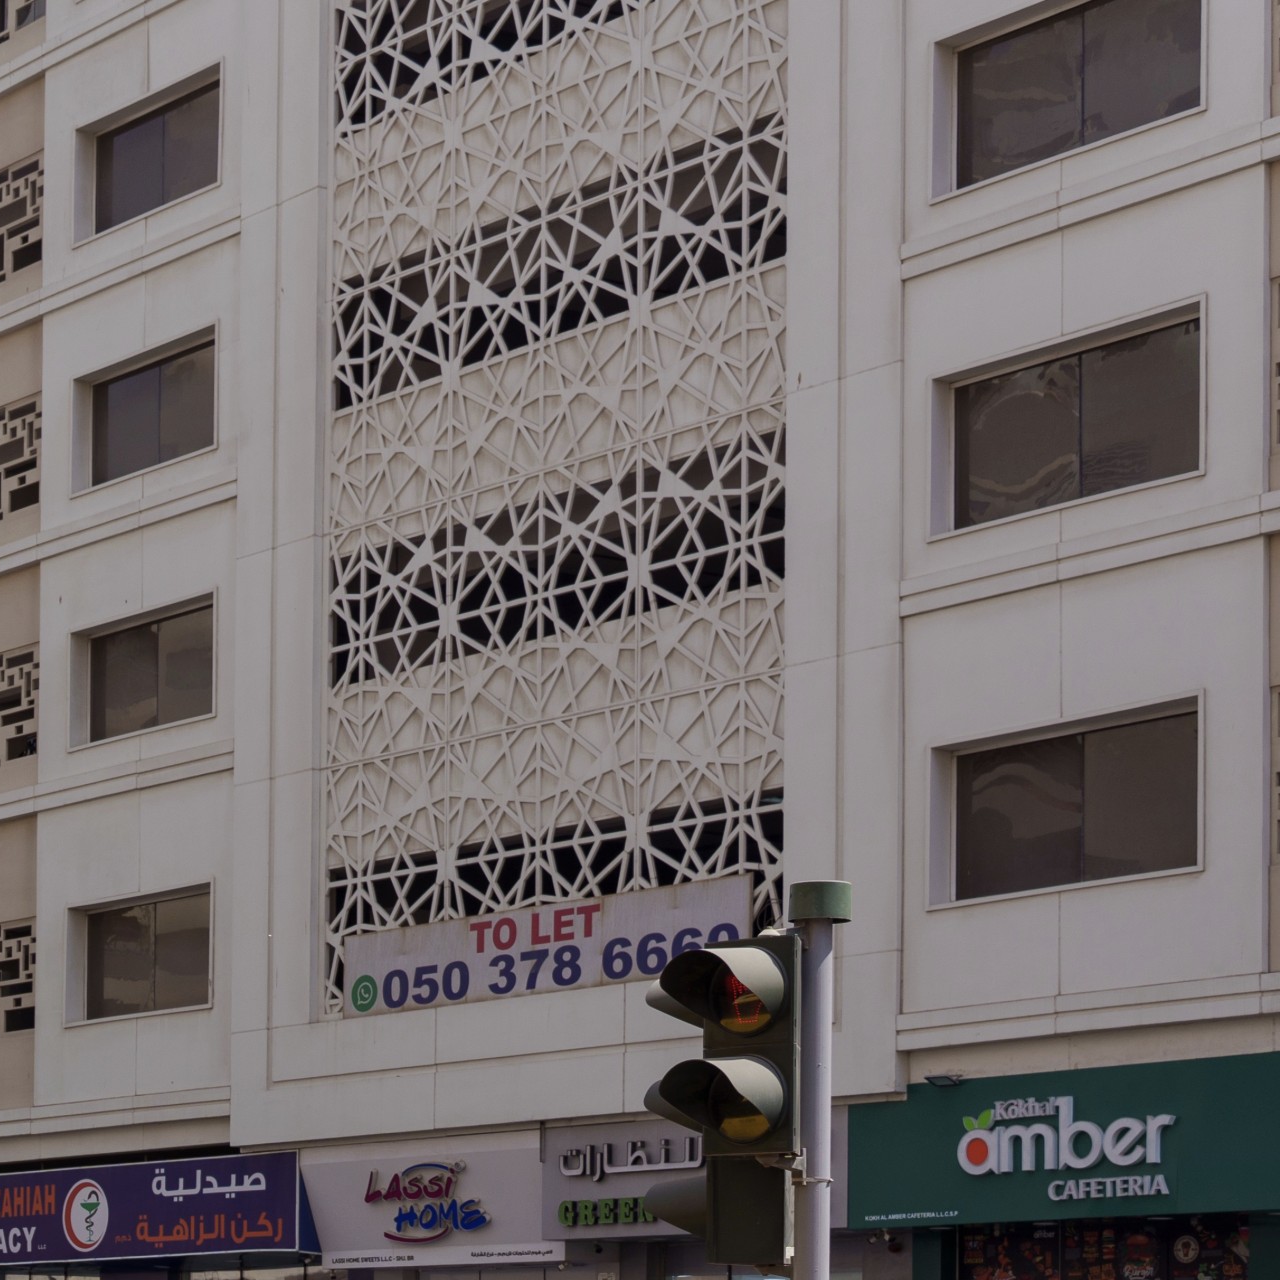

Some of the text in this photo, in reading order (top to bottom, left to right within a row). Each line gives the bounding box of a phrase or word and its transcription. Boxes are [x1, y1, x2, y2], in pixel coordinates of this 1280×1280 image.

[470, 904, 601, 954] TO LET
[382, 960, 470, 1009] 050
[488, 944, 582, 995] 378
[957, 1096, 1176, 1176] amber
[152, 1168, 266, 1202] صيدلية
[1047, 1175, 1170, 1201] CAFETERIA
[136, 1214, 225, 1248] الزاهية
[231, 1211, 284, 1246] ركن
[394, 1198, 491, 1232] HOME
